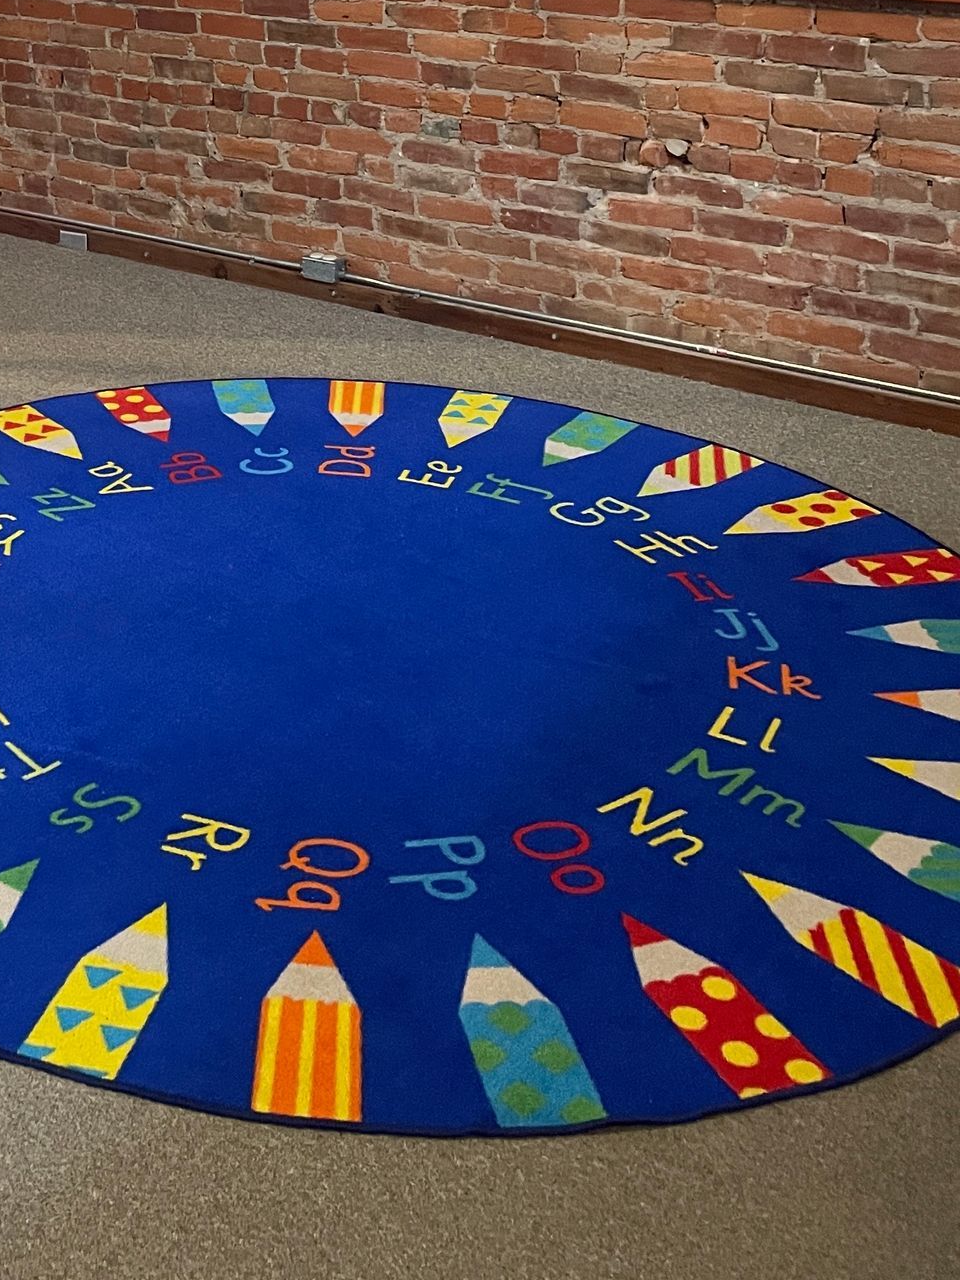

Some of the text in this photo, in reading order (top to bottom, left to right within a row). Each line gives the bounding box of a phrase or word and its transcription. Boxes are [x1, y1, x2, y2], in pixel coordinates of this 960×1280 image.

[88, 461, 154, 496] Aa
[159, 452, 224, 485] Bb
[238, 447, 295, 476] Cc
[318, 444, 376, 478] Dd
[397, 460, 462, 489] Ee
[31, 487, 96, 522] Zz
[464, 472, 554, 506] Ff
[549, 496, 651, 527] Gg
[613, 530, 719, 565] Hh
[713, 608, 780, 651] Jj
[726, 656, 822, 700] Kk
[666, 747, 807, 828] Mm
[159, 812, 251, 871] Rr
[596, 786, 705, 866] Nn
[255, 837, 371, 912] Qq
[388, 834, 487, 901] Pp
